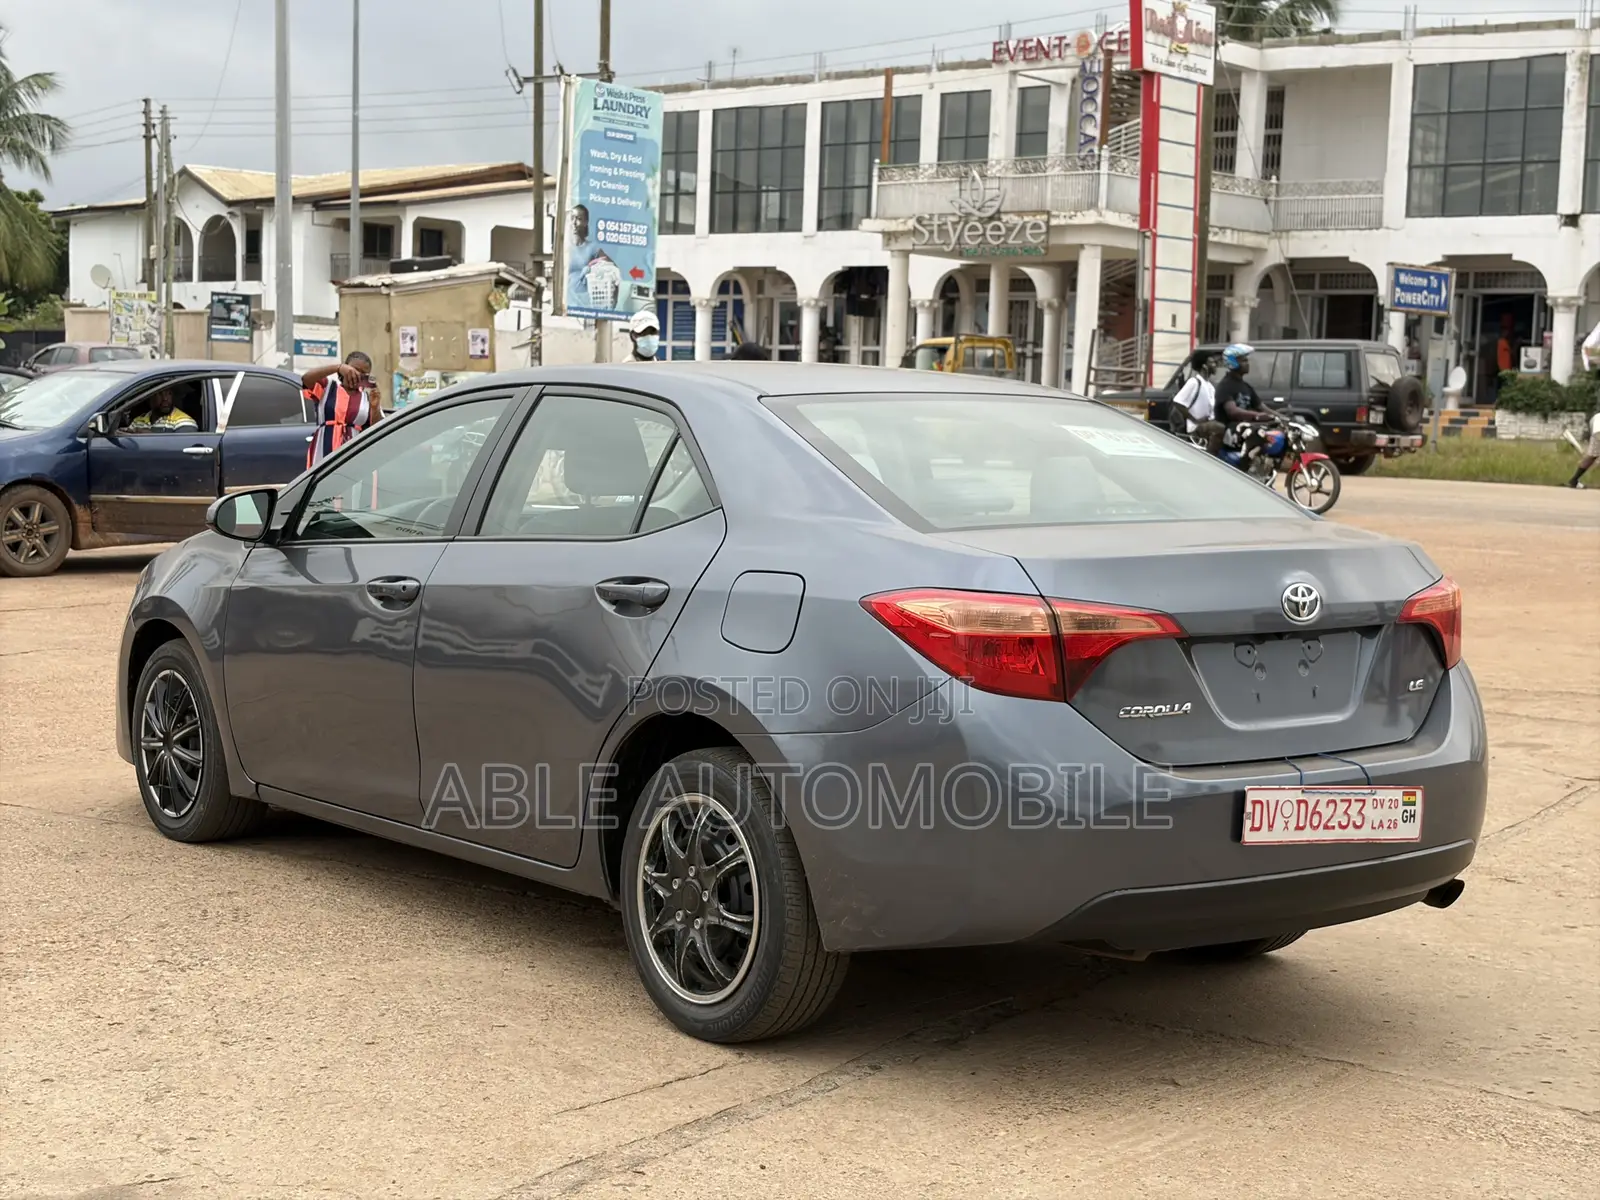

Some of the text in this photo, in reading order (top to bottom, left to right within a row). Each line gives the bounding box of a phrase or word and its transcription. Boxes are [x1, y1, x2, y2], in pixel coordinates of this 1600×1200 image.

[992, 35, 1067, 64] EVENT
[593, 97, 651, 119] LAUNDRY
[590, 149, 642, 164] Wash, Dry & Fold
[590, 164, 646, 181] Ironing & Pressing
[589, 179, 629, 193] Dry Cleaning
[589, 193, 610, 206] Pickup
[617, 198, 642, 209] Delivery
[910, 213, 1047, 252] Styeeze
[1399, 272, 1438, 289] Welcome To
[1409, 679, 1424, 691] LE
[1118, 701, 1192, 719] COROLLA
[1372, 798, 1399, 810] DV 20
[1371, 818, 1398, 830] LA 26
[1401, 809, 1416, 824] GH
